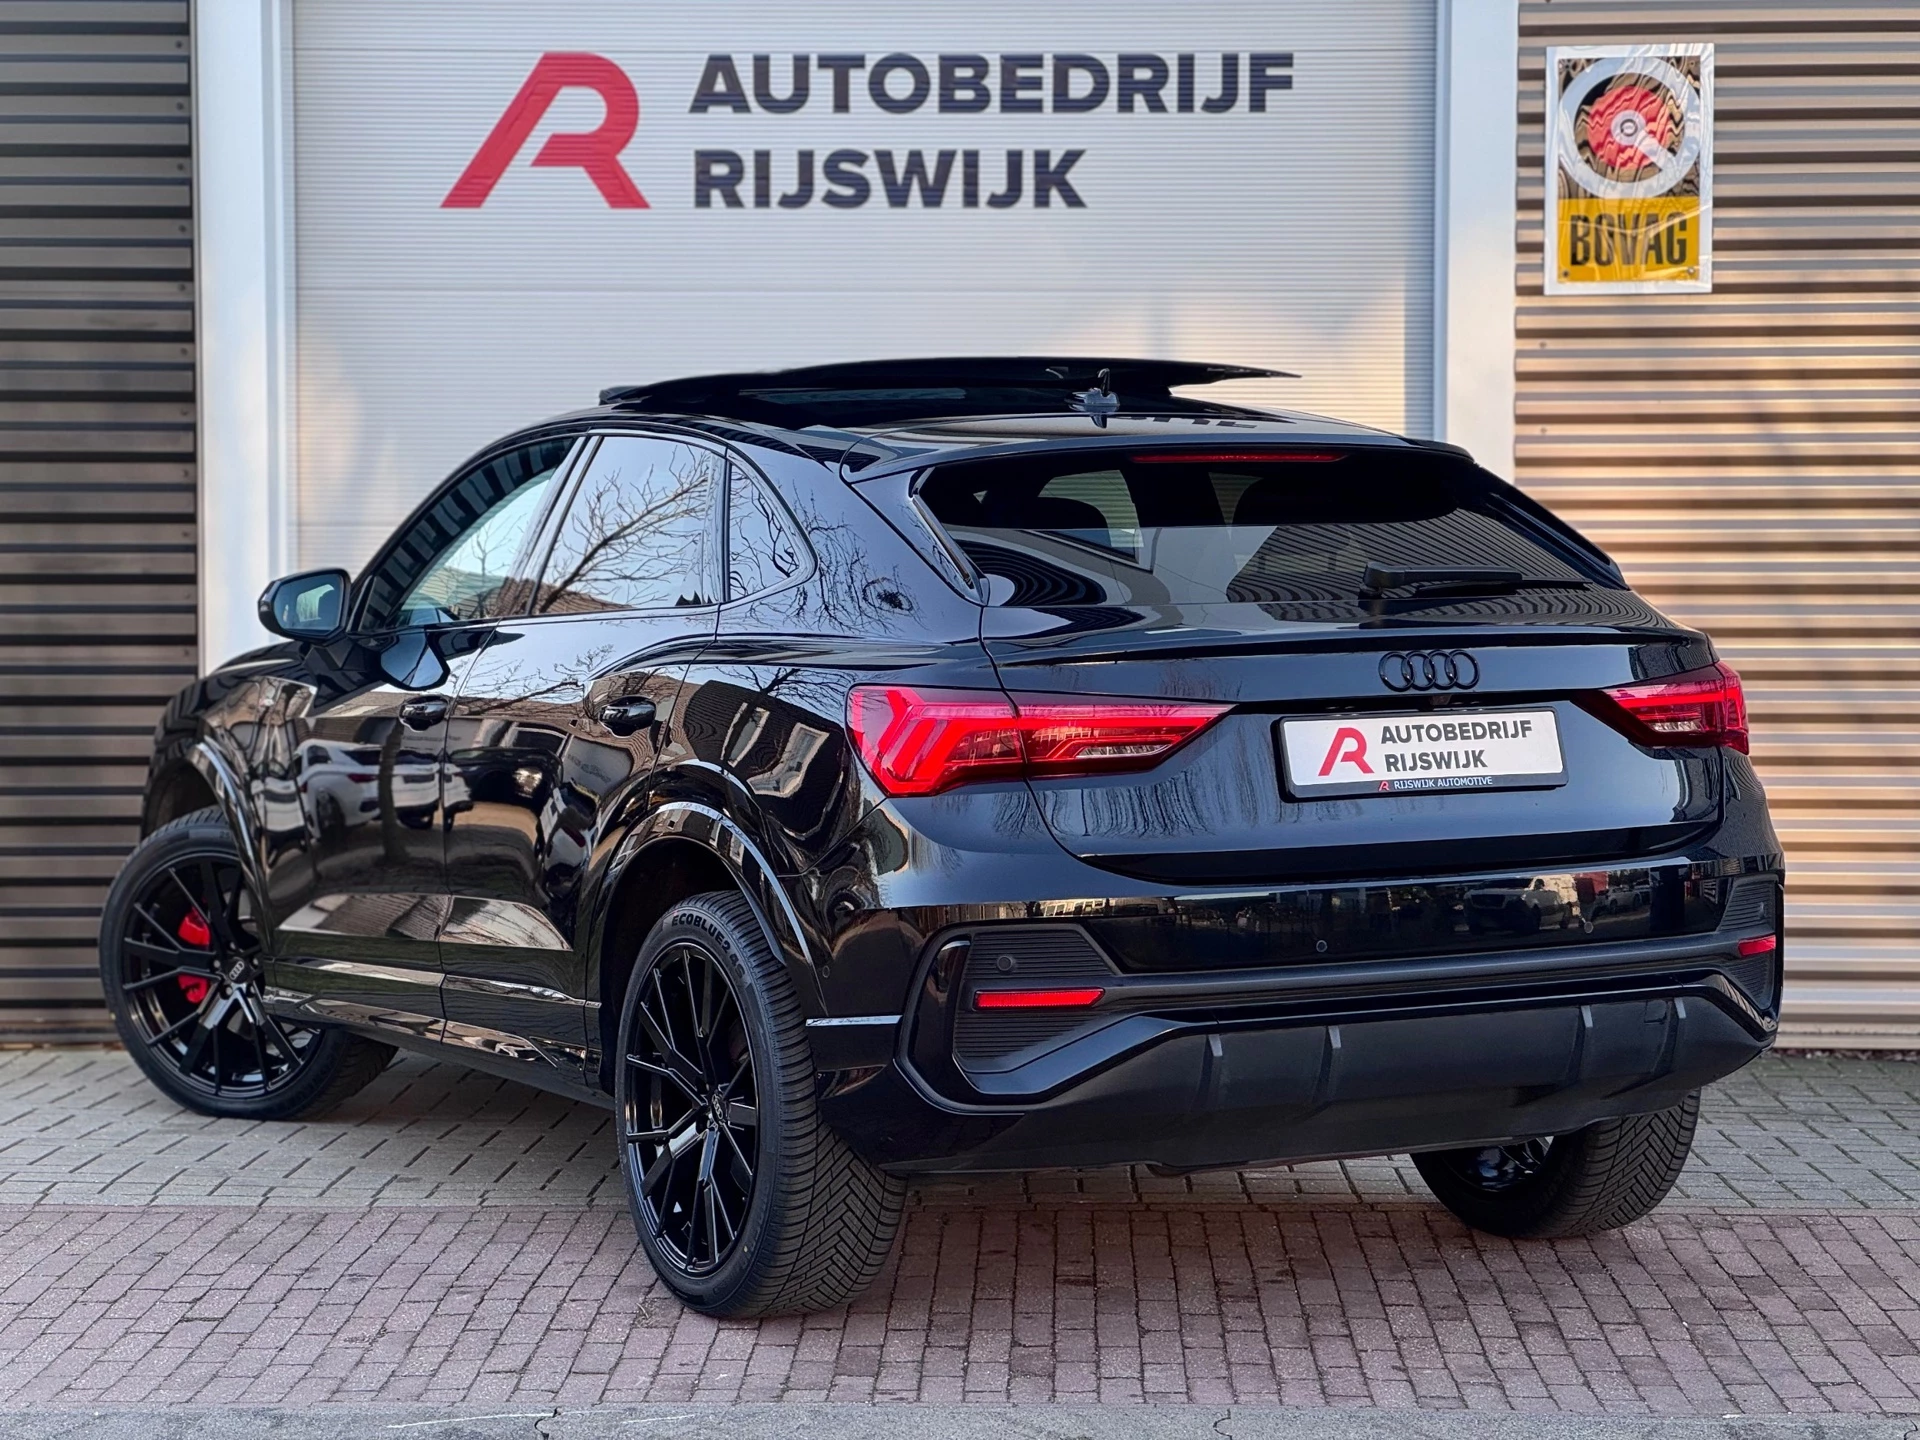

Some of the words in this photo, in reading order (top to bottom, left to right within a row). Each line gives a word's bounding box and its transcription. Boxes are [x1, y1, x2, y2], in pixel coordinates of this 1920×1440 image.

[689, 52, 1294, 115] AUTOBEDRIJF
[694, 149, 1087, 209] RIJSWIJK
[1570, 212, 1687, 267] BOVAG
[1380, 719, 1533, 745] AUTOBEDRIJF
[1384, 749, 1488, 773] RIJSWIJK
[1393, 779, 1436, 791] RIJSWIJK
[1437, 776, 1493, 788] AUTOMOTIVE
